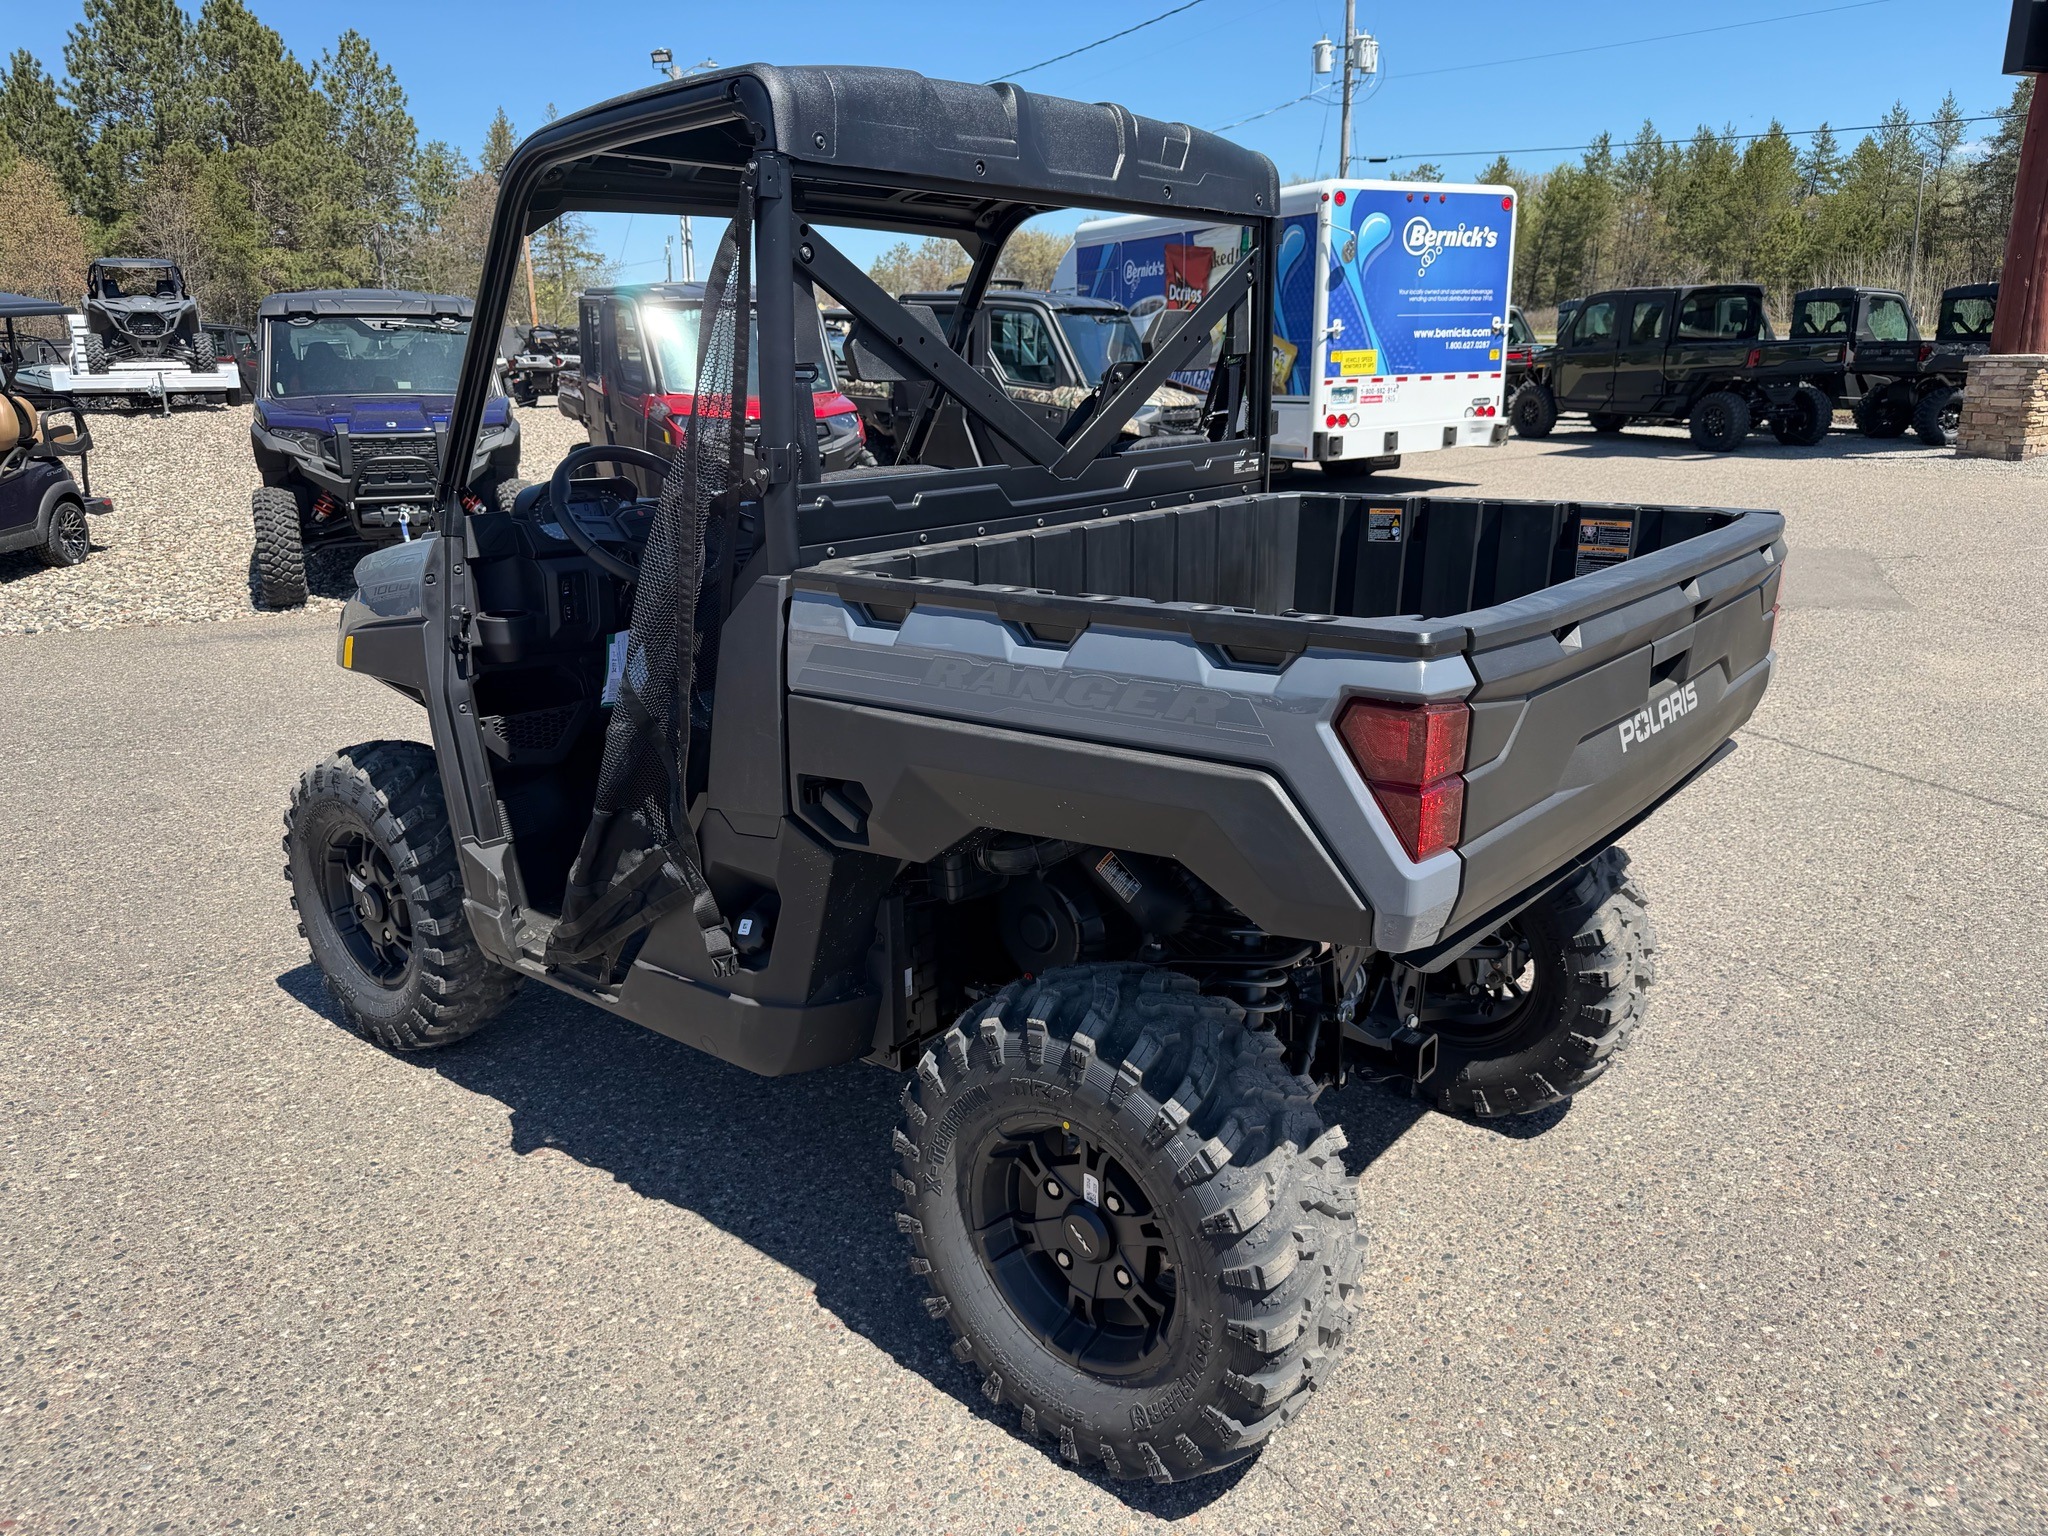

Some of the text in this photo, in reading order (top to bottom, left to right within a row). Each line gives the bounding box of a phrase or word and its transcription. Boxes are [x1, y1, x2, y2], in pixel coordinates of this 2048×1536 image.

[1407, 222, 1498, 248] Bernick's
[1125, 261, 1164, 280] Bernick's
[920, 655, 1230, 724] RANGER
[1618, 681, 1698, 754] POLARIS
[923, 1084, 992, 1197] X-TERRAIN
